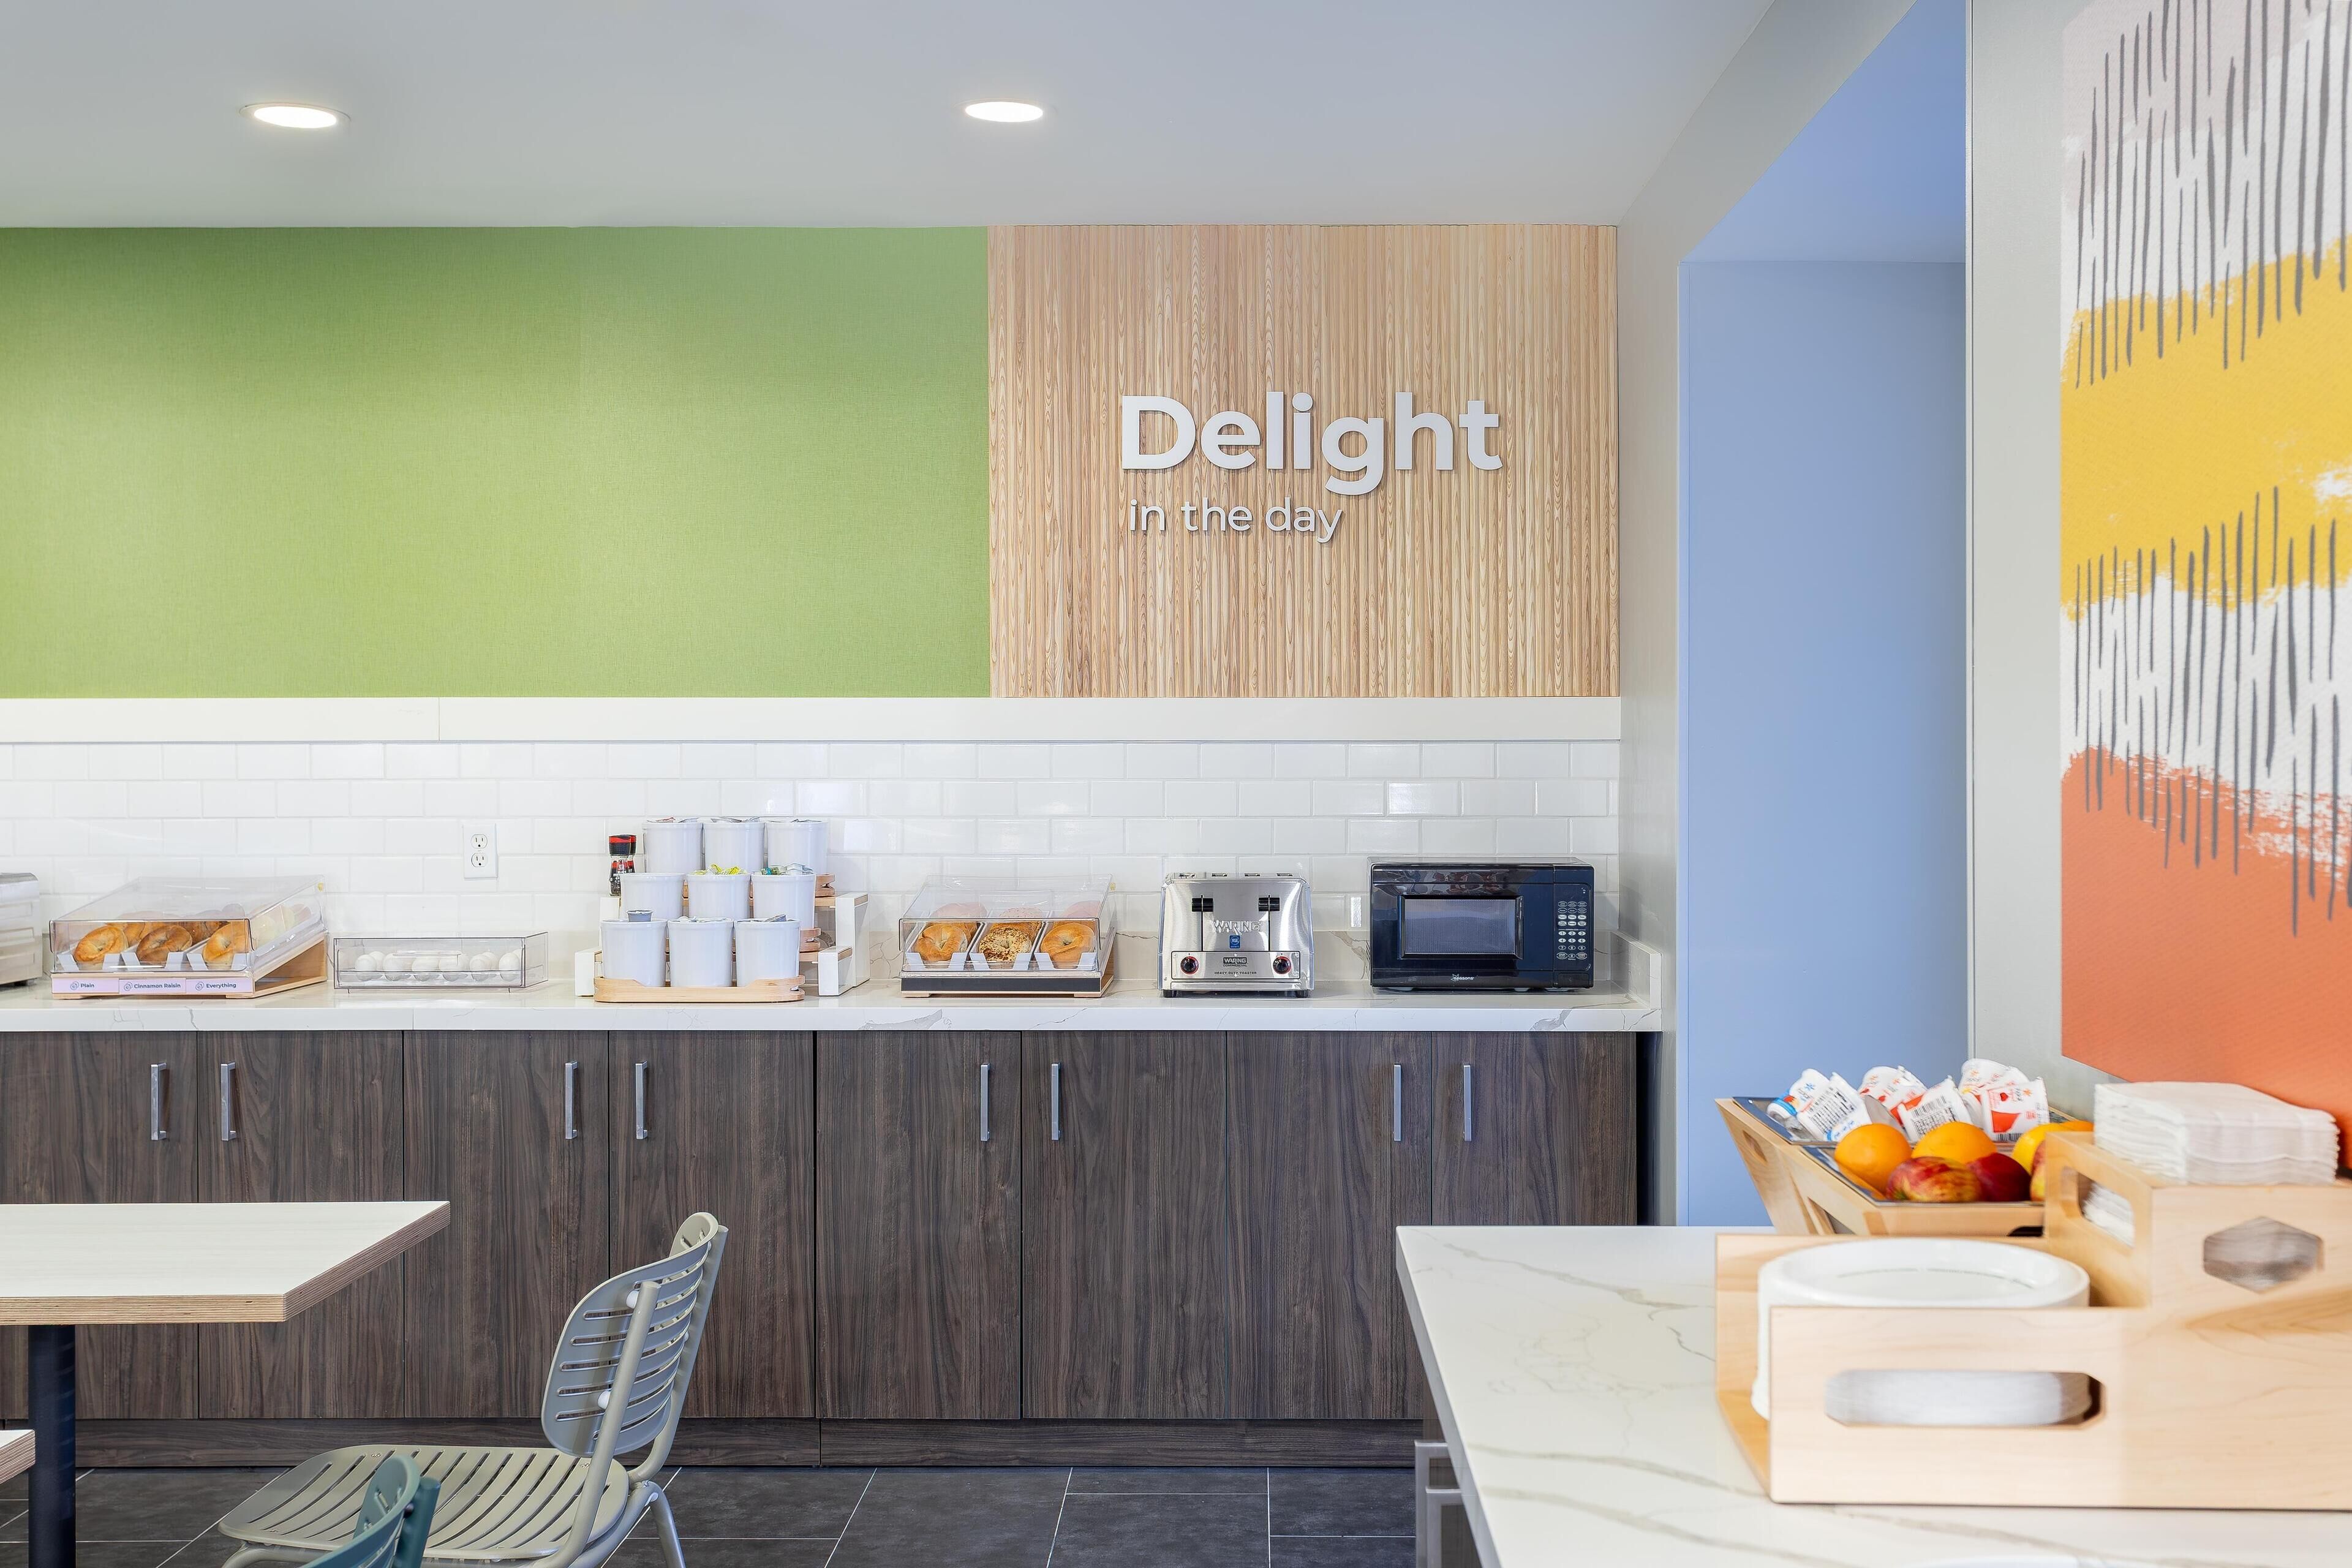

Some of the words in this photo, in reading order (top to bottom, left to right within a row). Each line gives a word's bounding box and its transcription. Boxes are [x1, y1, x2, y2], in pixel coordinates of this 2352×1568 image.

[1122, 391, 1503, 496] Delight
[1130, 499, 1165, 532] in
[1181, 497, 1253, 532] the
[1265, 497, 1343, 543] day
[1211, 920, 1262, 935] WARING
